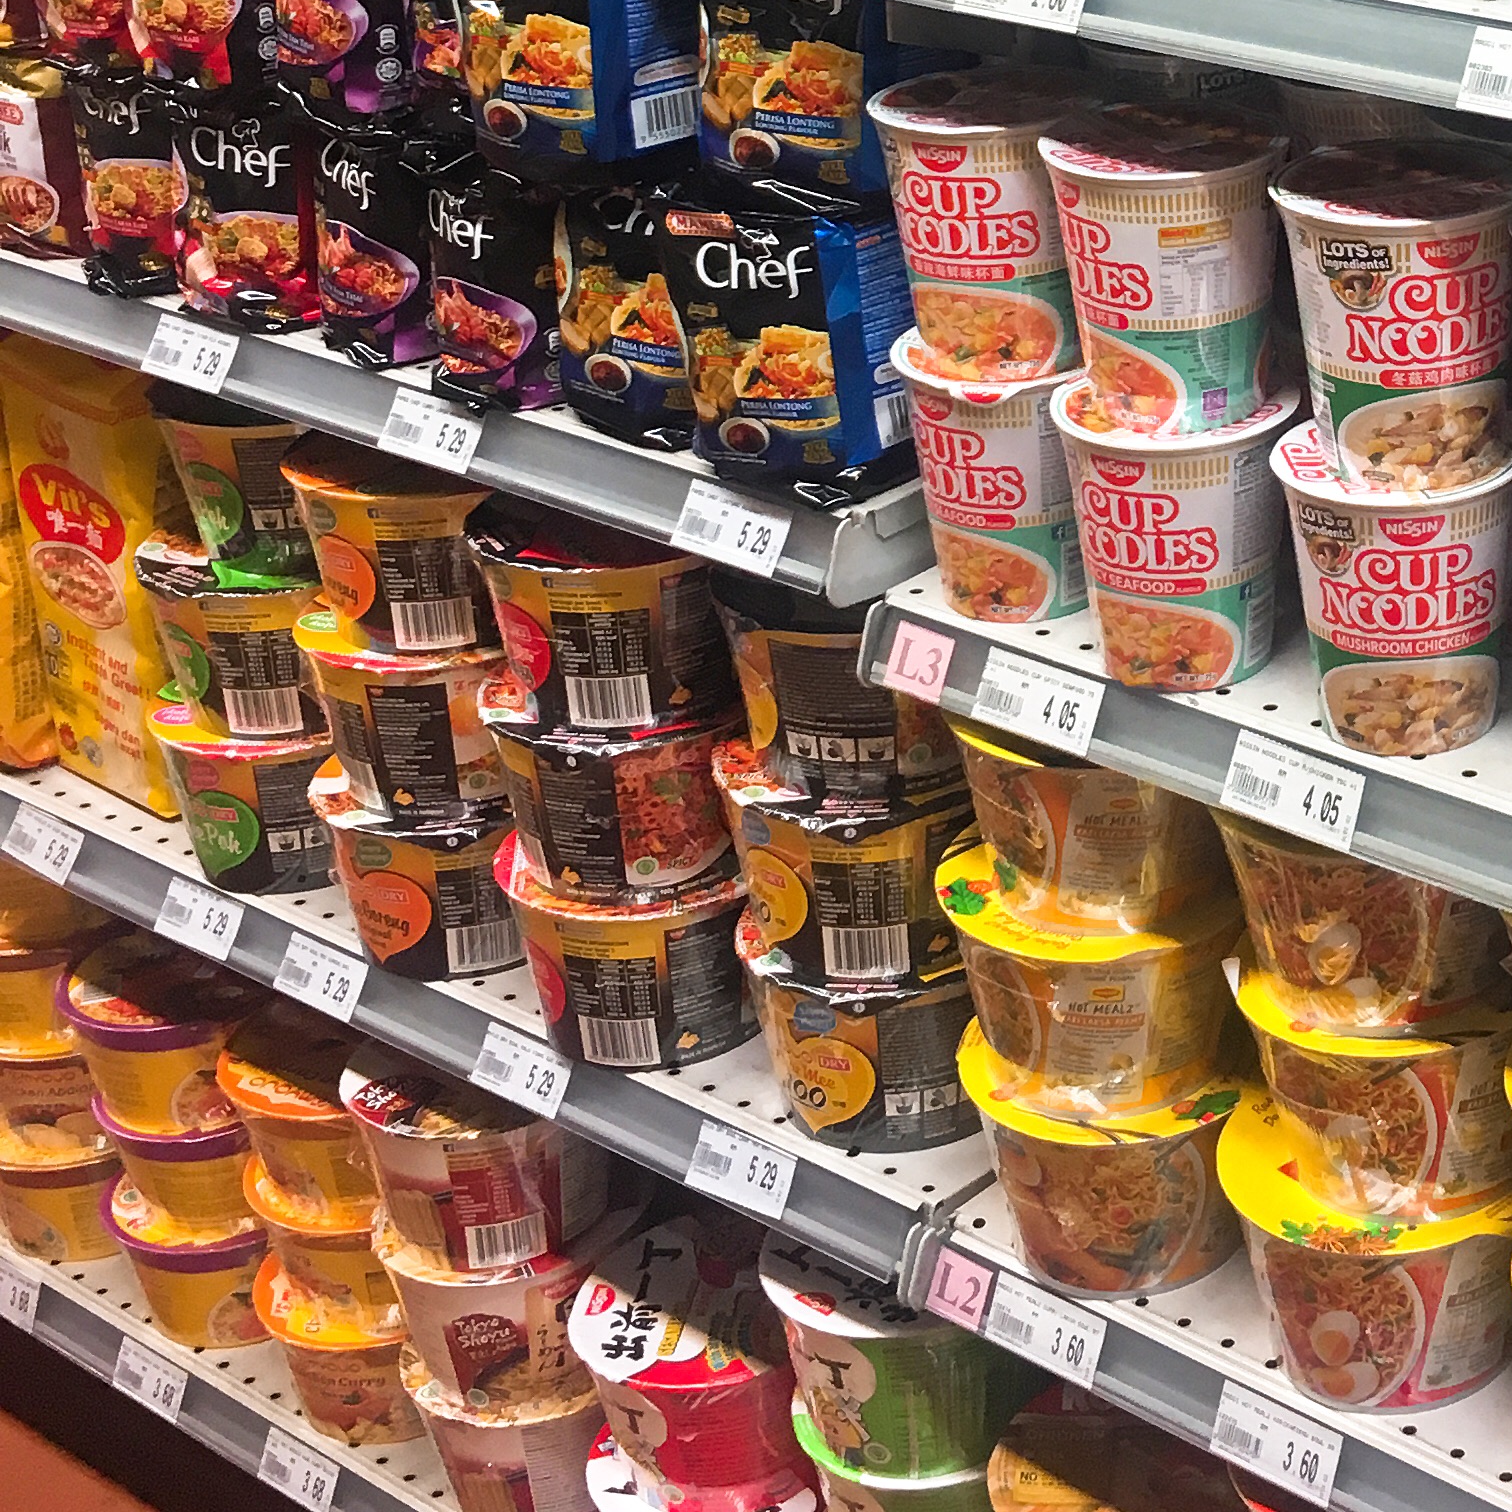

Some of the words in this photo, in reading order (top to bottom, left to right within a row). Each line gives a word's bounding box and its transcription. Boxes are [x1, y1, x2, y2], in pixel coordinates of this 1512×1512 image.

[755, 112, 784, 127] PERISA
[786, 113, 835, 130] LONTONG
[191, 126, 290, 187] Chef
[321, 138, 377, 210] Chef
[428, 188, 495, 260] Chef
[696, 242, 814, 299] Chef
[193, 351, 221, 378] 5.29
[436, 426, 467, 455] 5.29
[32, 473, 111, 528] Vit's
[738, 522, 772, 554] 5.29
[1109, 574, 1175, 594] SEAFOOD
[1322, 580, 1496, 632] NOODLES
[1336, 633, 1414, 655] MUSHROOM
[1415, 632, 1471, 654] CHICKEN
[894, 637, 943, 687] L3
[1043, 694, 1079, 732] 4.05
[1302, 785, 1341, 826] 4.05
[44, 838, 69, 869] 5.29
[203, 908, 229, 937] 5.29
[322, 972, 351, 1003] 5.29
[819, 1057, 850, 1069] DRY
[525, 1065, 555, 1097] 5.29
[747, 1155, 779, 1190] 5.29
[936, 1261, 982, 1317] L2
[1050, 1326, 1085, 1367] 3.60
[152, 1378, 176, 1408] 3.68
[1282, 1441, 1320, 1483] 3.60
[302, 1470, 326, 1502] 3.68
